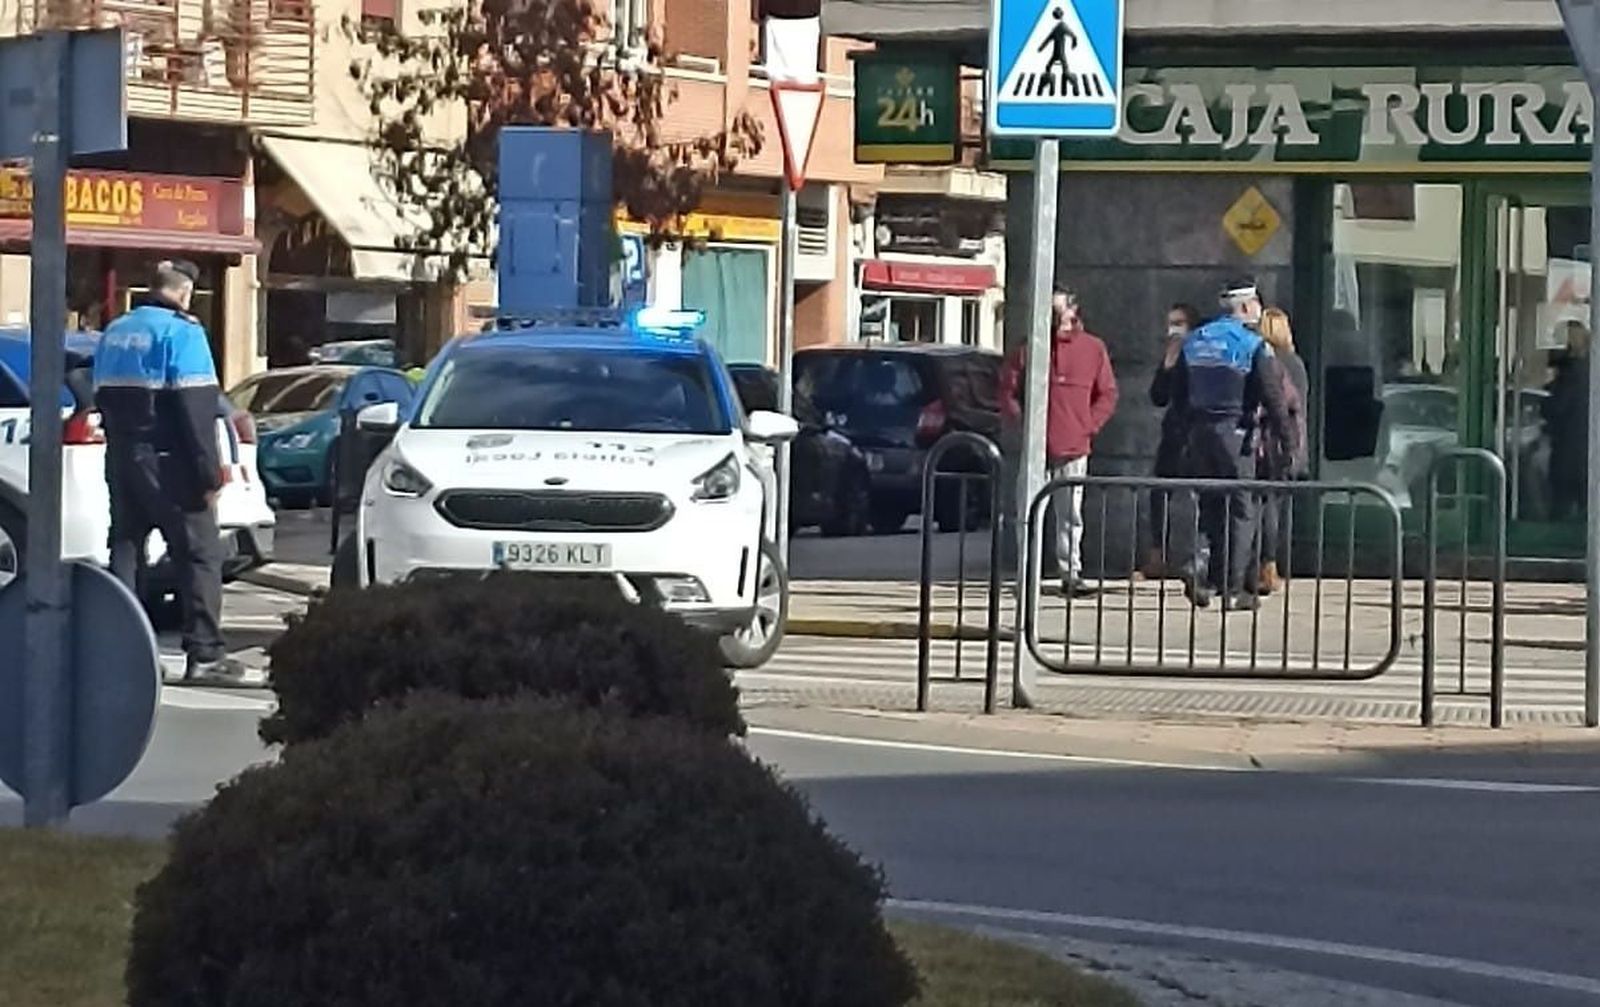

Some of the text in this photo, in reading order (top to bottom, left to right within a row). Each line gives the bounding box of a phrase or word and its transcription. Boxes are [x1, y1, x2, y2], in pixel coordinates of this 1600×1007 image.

[877, 96, 934, 131] 24h
[1118, 82, 1319, 150] CAJA
[507, 543, 604, 563] 9326 KLT
